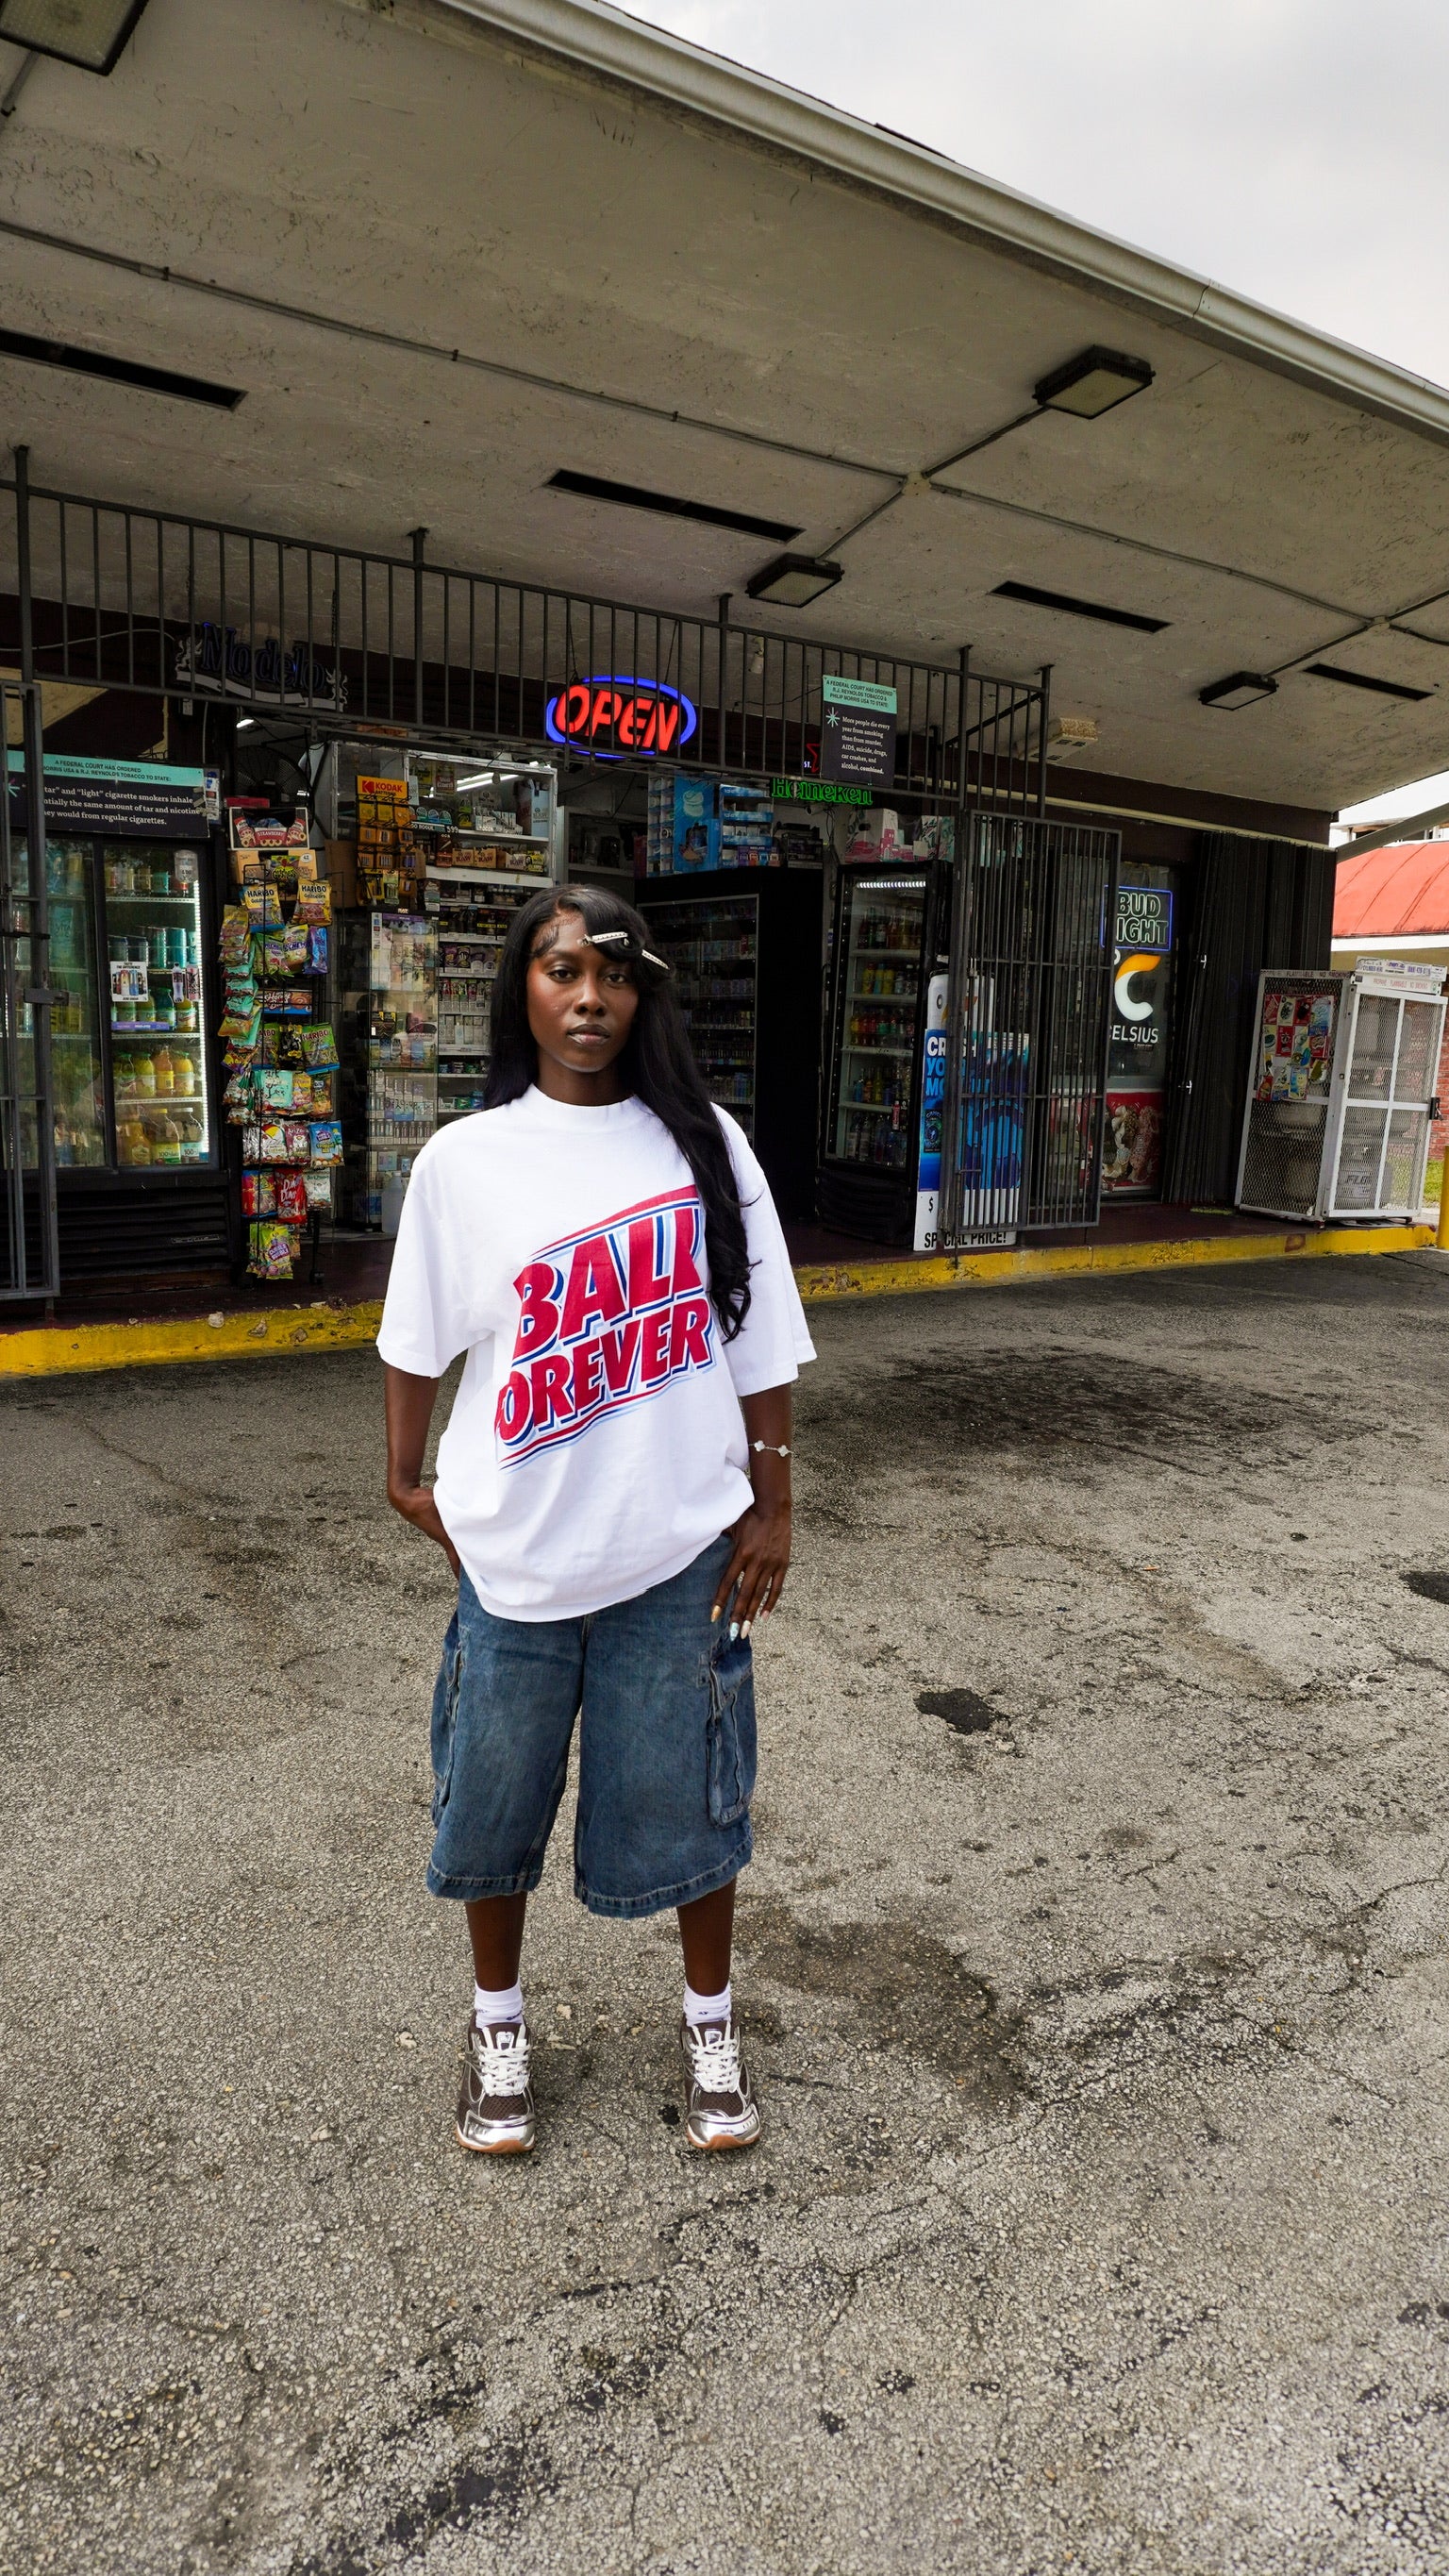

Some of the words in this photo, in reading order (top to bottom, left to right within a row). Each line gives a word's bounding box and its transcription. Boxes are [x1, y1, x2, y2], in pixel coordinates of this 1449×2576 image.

[201, 622, 326, 692] Modelo
[830, 680, 850, 689] FEDERAL
[874, 688, 893, 696] ORDERED
[841, 688, 864, 696] REYNOLDS
[555, 685, 678, 752] OPEN
[842, 716, 855, 725] More
[855, 718, 870, 727] people
[864, 728, 884, 739] smoking
[841, 744, 856, 752] AIDS,
[60, 760, 84, 768] FEDERAL
[841, 762, 859, 771] alcohol,
[859, 766, 884, 775] combined.
[375, 781, 403, 793] KODAK
[771, 778, 874, 806] Heineken
[105, 791, 137, 800] cigarette
[138, 794, 169, 802] smokers
[170, 795, 193, 804] inhale
[104, 802, 133, 811] amount
[101, 813, 128, 823] regular
[128, 814, 167, 825] cigarettes.
[1117, 891, 1161, 918] BUD
[1105, 916, 1170, 945] IGHT
[302, 1029, 329, 1041] HARIBO
[928, 1196, 934, 1213] $
[924, 1231, 968, 1247] SPCIAL
[971, 1231, 1007, 1245] PRICE!
[513, 1207, 706, 1365] BALL
[495, 1298, 714, 1447] OREVER
